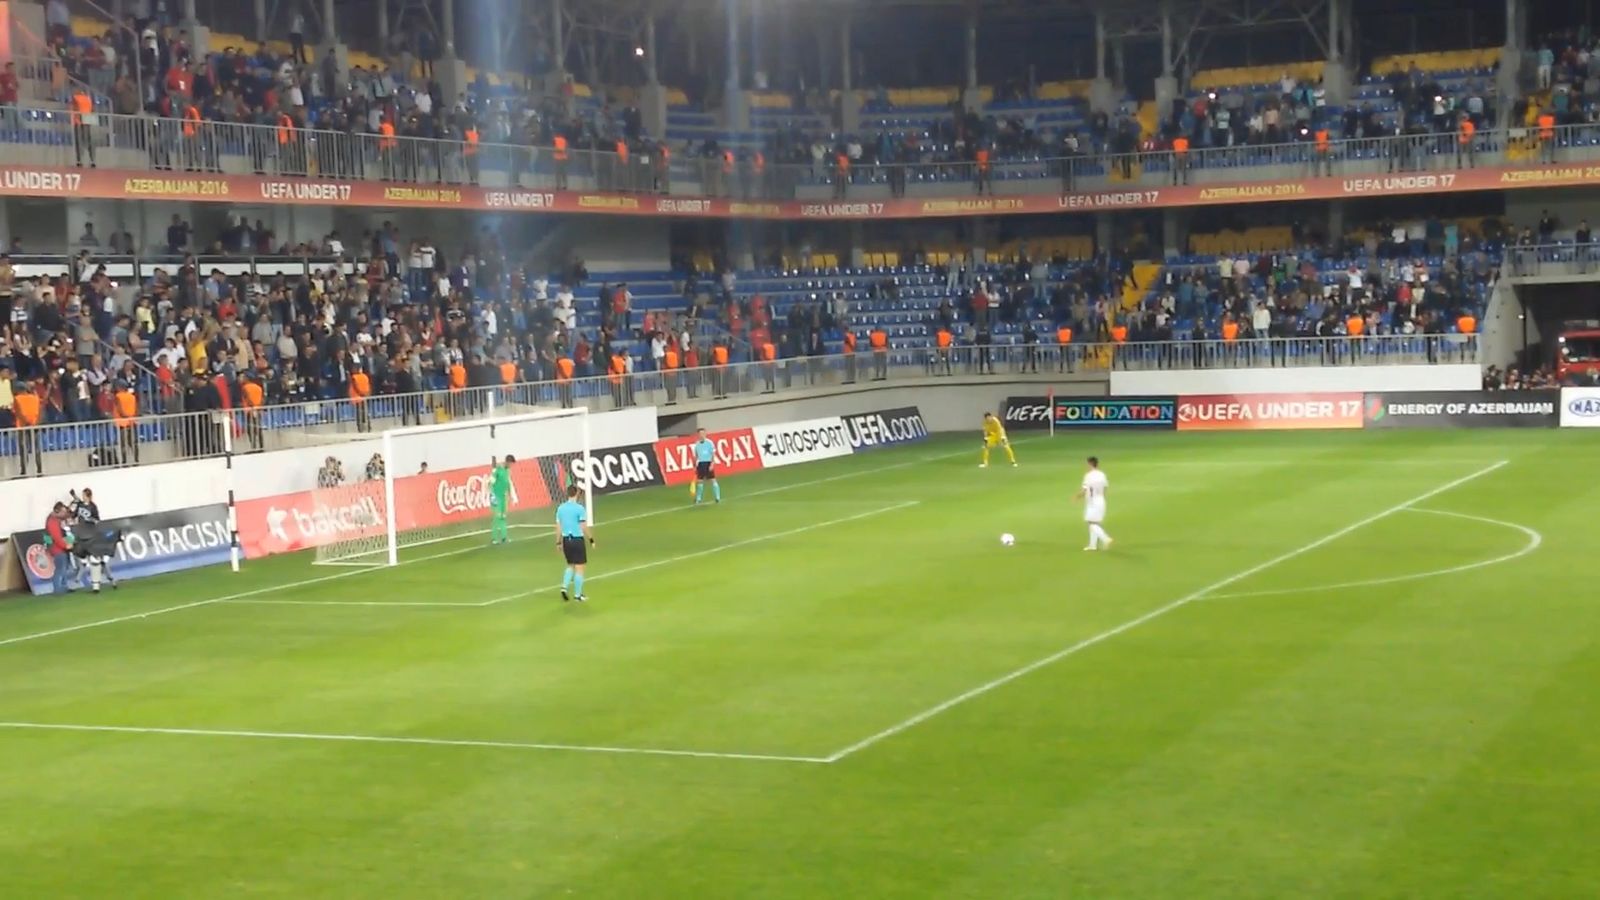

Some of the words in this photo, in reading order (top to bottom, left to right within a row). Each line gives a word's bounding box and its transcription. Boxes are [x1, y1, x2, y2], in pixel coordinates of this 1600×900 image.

[5, 171, 63, 190] UNDER
[65, 173, 80, 191] 17
[200, 182, 229, 195] 2016
[1274, 183, 1305, 196] 2016
[1343, 179, 1380, 193] UEFA
[1383, 176, 1437, 190] UNDER
[1439, 173, 1456, 187] 17
[261, 183, 295, 199] UEFA
[296, 184, 339, 200] UNDER
[340, 185, 351, 200] 17
[439, 189, 461, 203] 2016
[485, 192, 510, 207] UEFA
[511, 193, 543, 208] UNDER
[544, 194, 554, 207] 17
[1058, 195, 1094, 208] UEFA
[1095, 192, 1143, 206] UNDER
[1144, 191, 1159, 204] 17
[800, 204, 828, 216] UEFA
[829, 204, 870, 216] UNDER
[871, 202, 884, 215] 17
[1006, 405, 1051, 421] UEFA
[1055, 404, 1174, 420] FOUNDATION
[1198, 404, 1252, 420] UEFA
[1257, 402, 1333, 419] UNDER
[1338, 400, 1360, 417] 17
[1388, 403, 1445, 416] ENERGY
[1449, 403, 1466, 414] OF
[1468, 402, 1554, 415] AZERBAIJAN
[843, 414, 928, 448] UEFA.com
[664, 434, 755, 472] AZÇAY
[570, 451, 653, 490] SOCAR
[149, 518, 238, 555] RACISM
